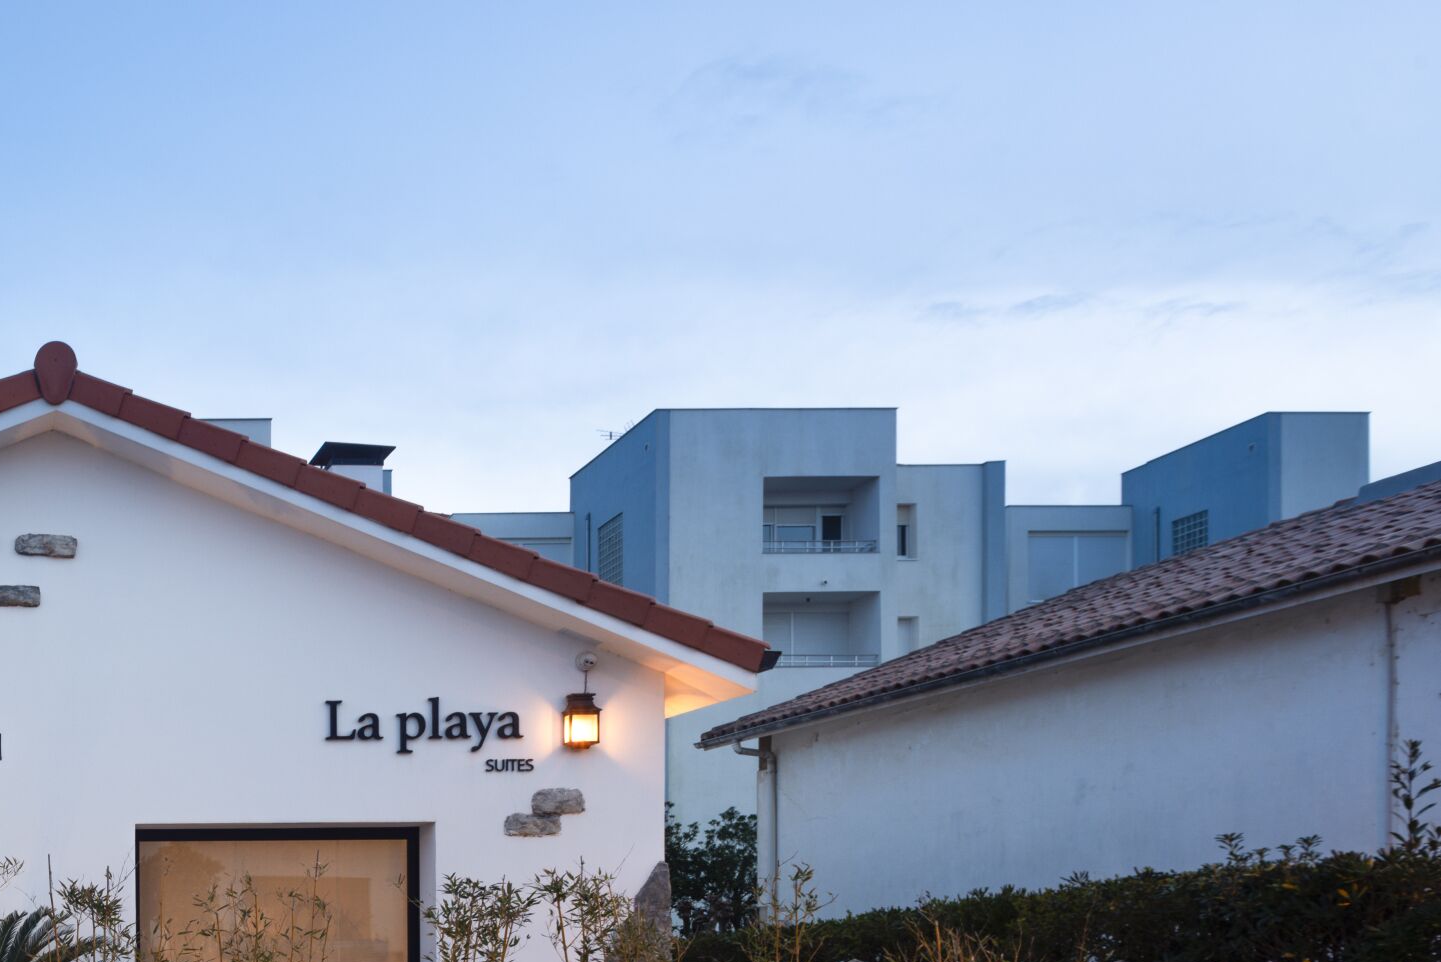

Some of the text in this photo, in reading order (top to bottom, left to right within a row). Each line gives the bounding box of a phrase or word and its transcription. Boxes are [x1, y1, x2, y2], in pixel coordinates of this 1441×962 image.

[325, 696, 523, 754] La playa
[485, 758, 534, 772] SUITES
